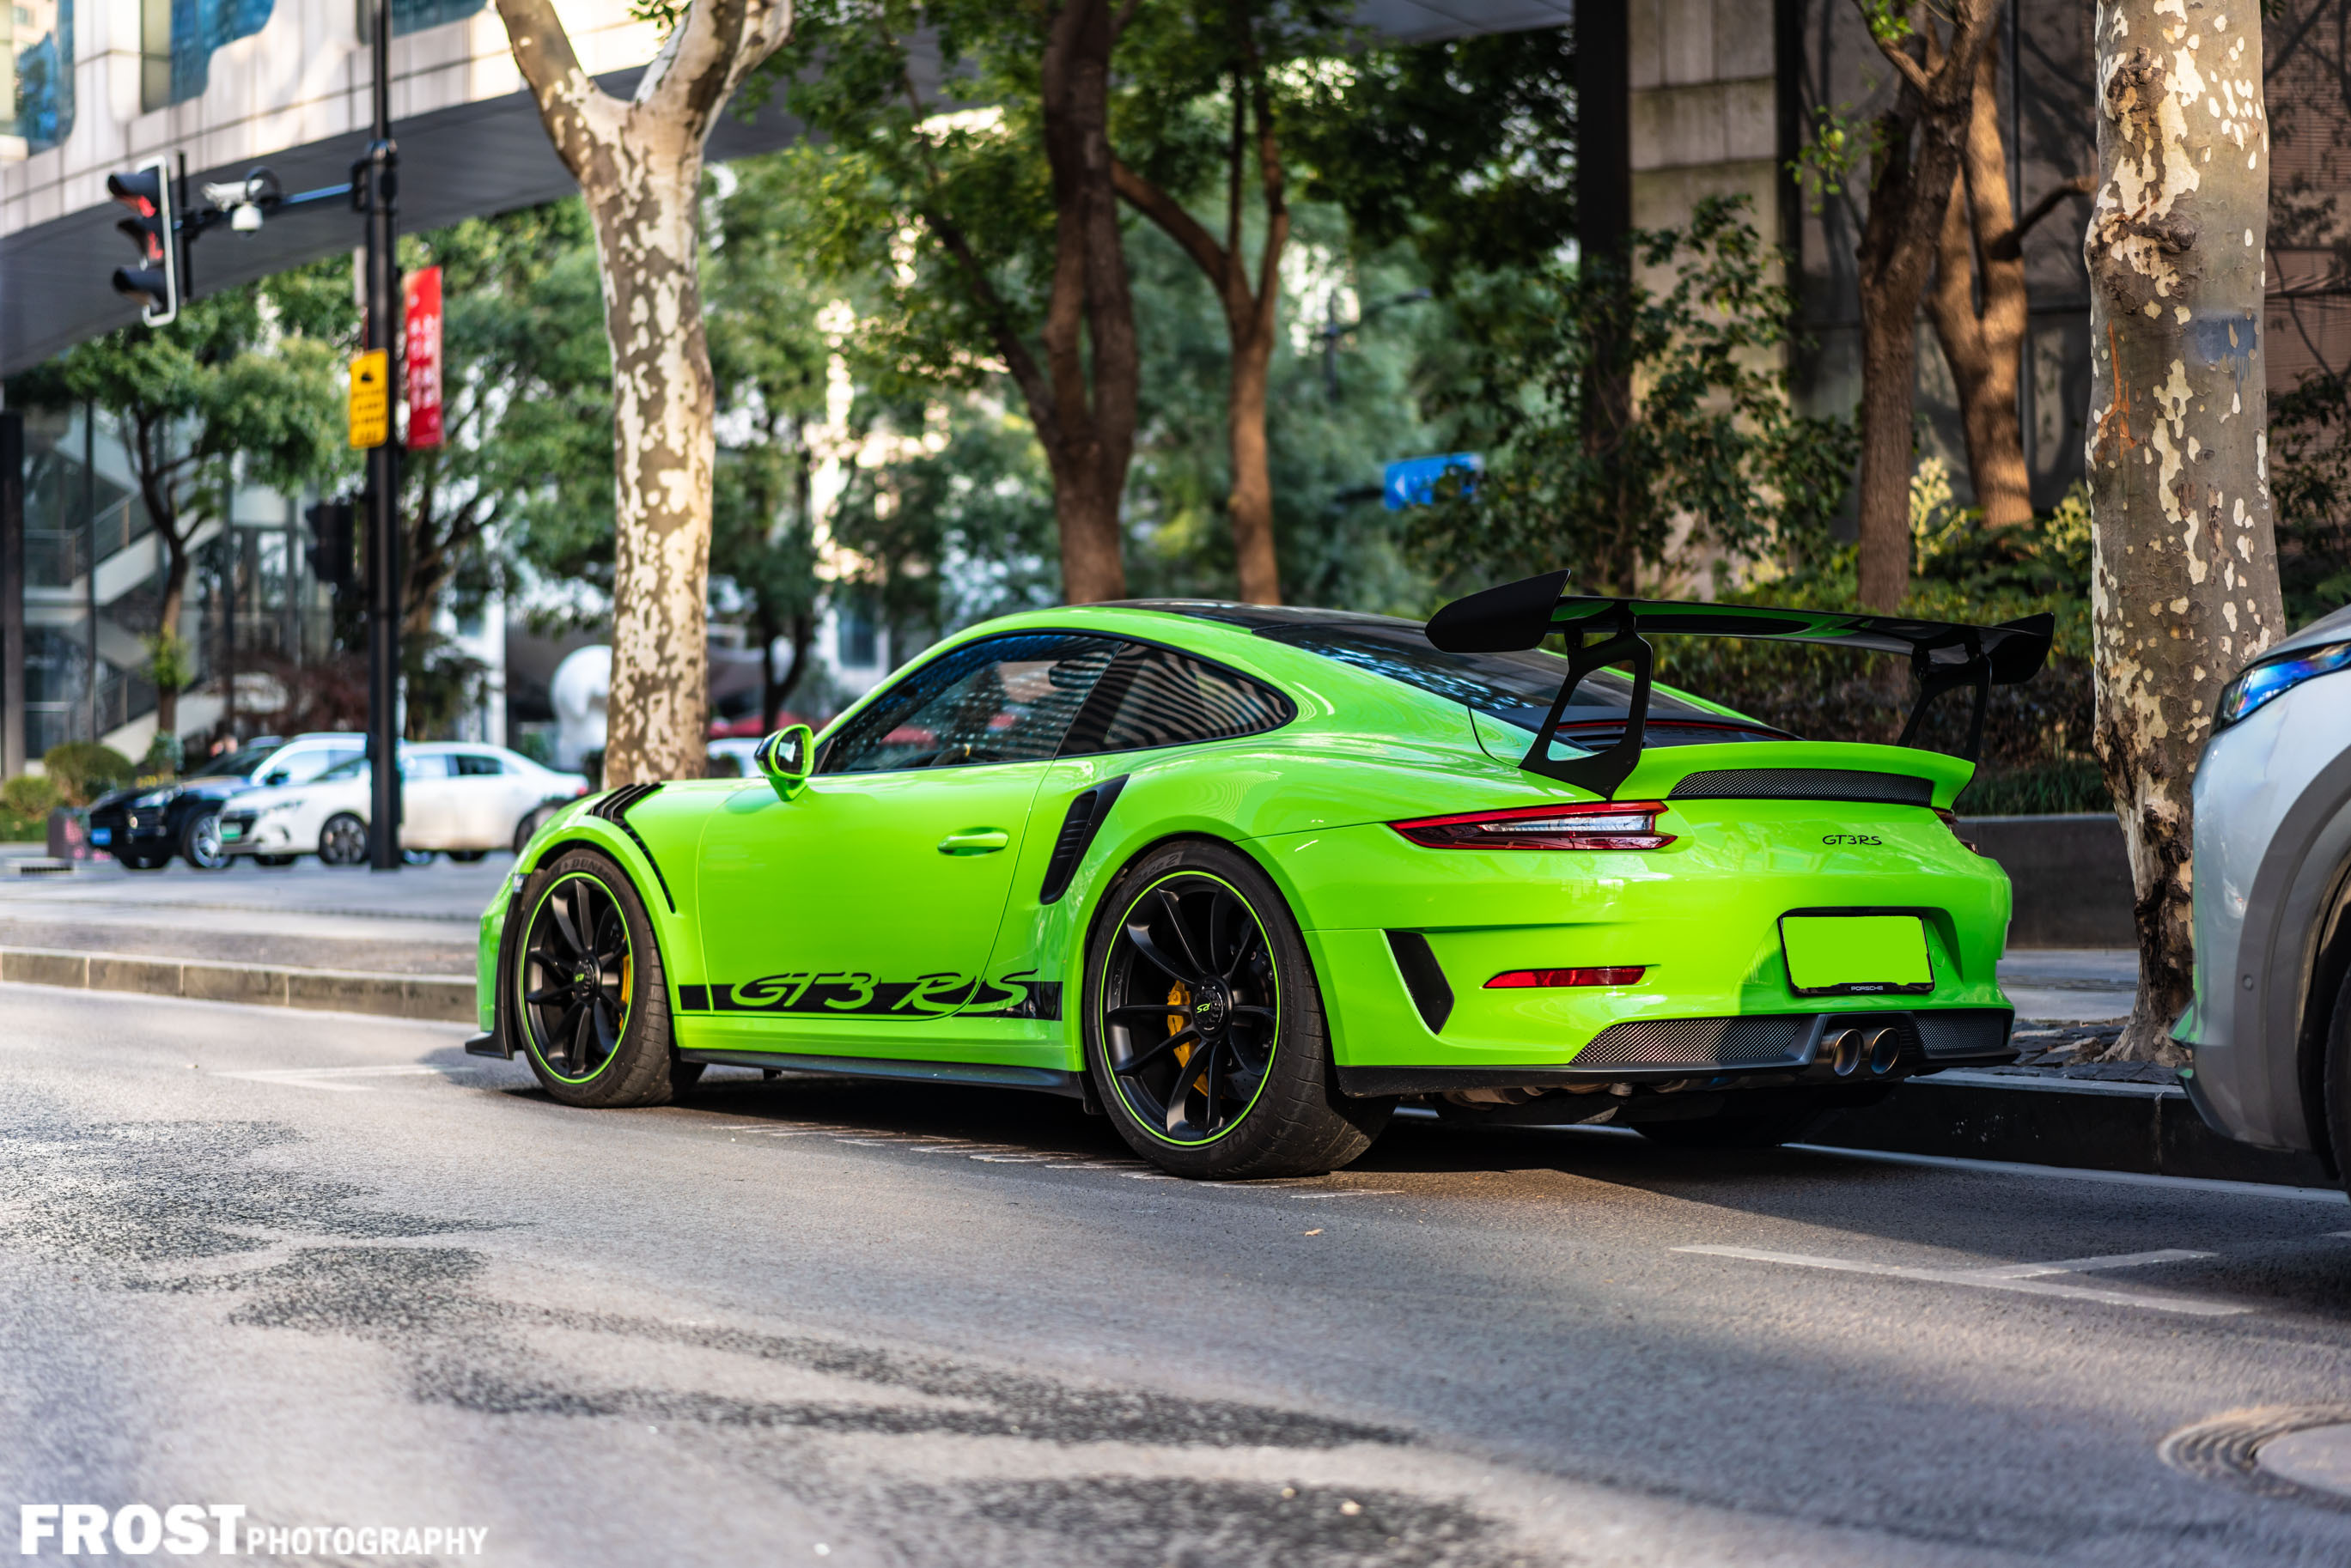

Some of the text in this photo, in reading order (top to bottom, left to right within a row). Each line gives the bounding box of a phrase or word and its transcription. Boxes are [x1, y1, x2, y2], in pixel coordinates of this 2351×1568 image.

[1822, 834, 1883, 846] GT3RS
[729, 968, 1038, 1014] GT3 RS
